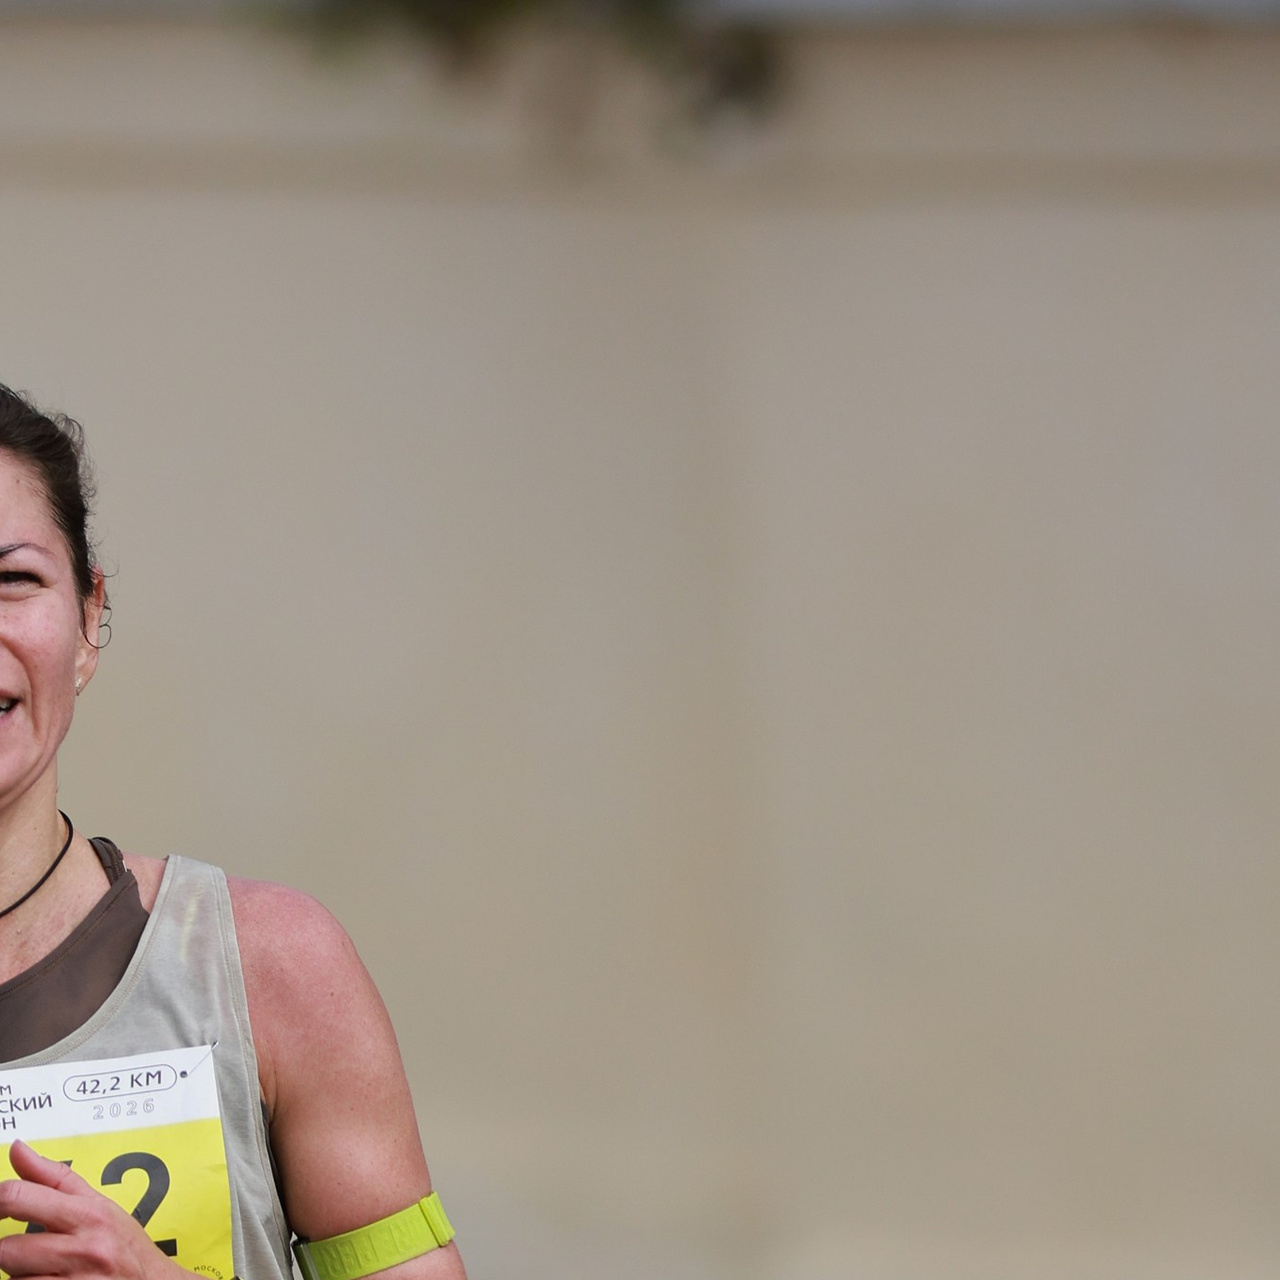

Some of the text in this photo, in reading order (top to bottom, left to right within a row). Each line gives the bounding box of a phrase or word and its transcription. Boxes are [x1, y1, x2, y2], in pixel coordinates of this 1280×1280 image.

[75, 1070, 162, 1096] 42,2 КМ
[92, 1097, 156, 1121] 2026
